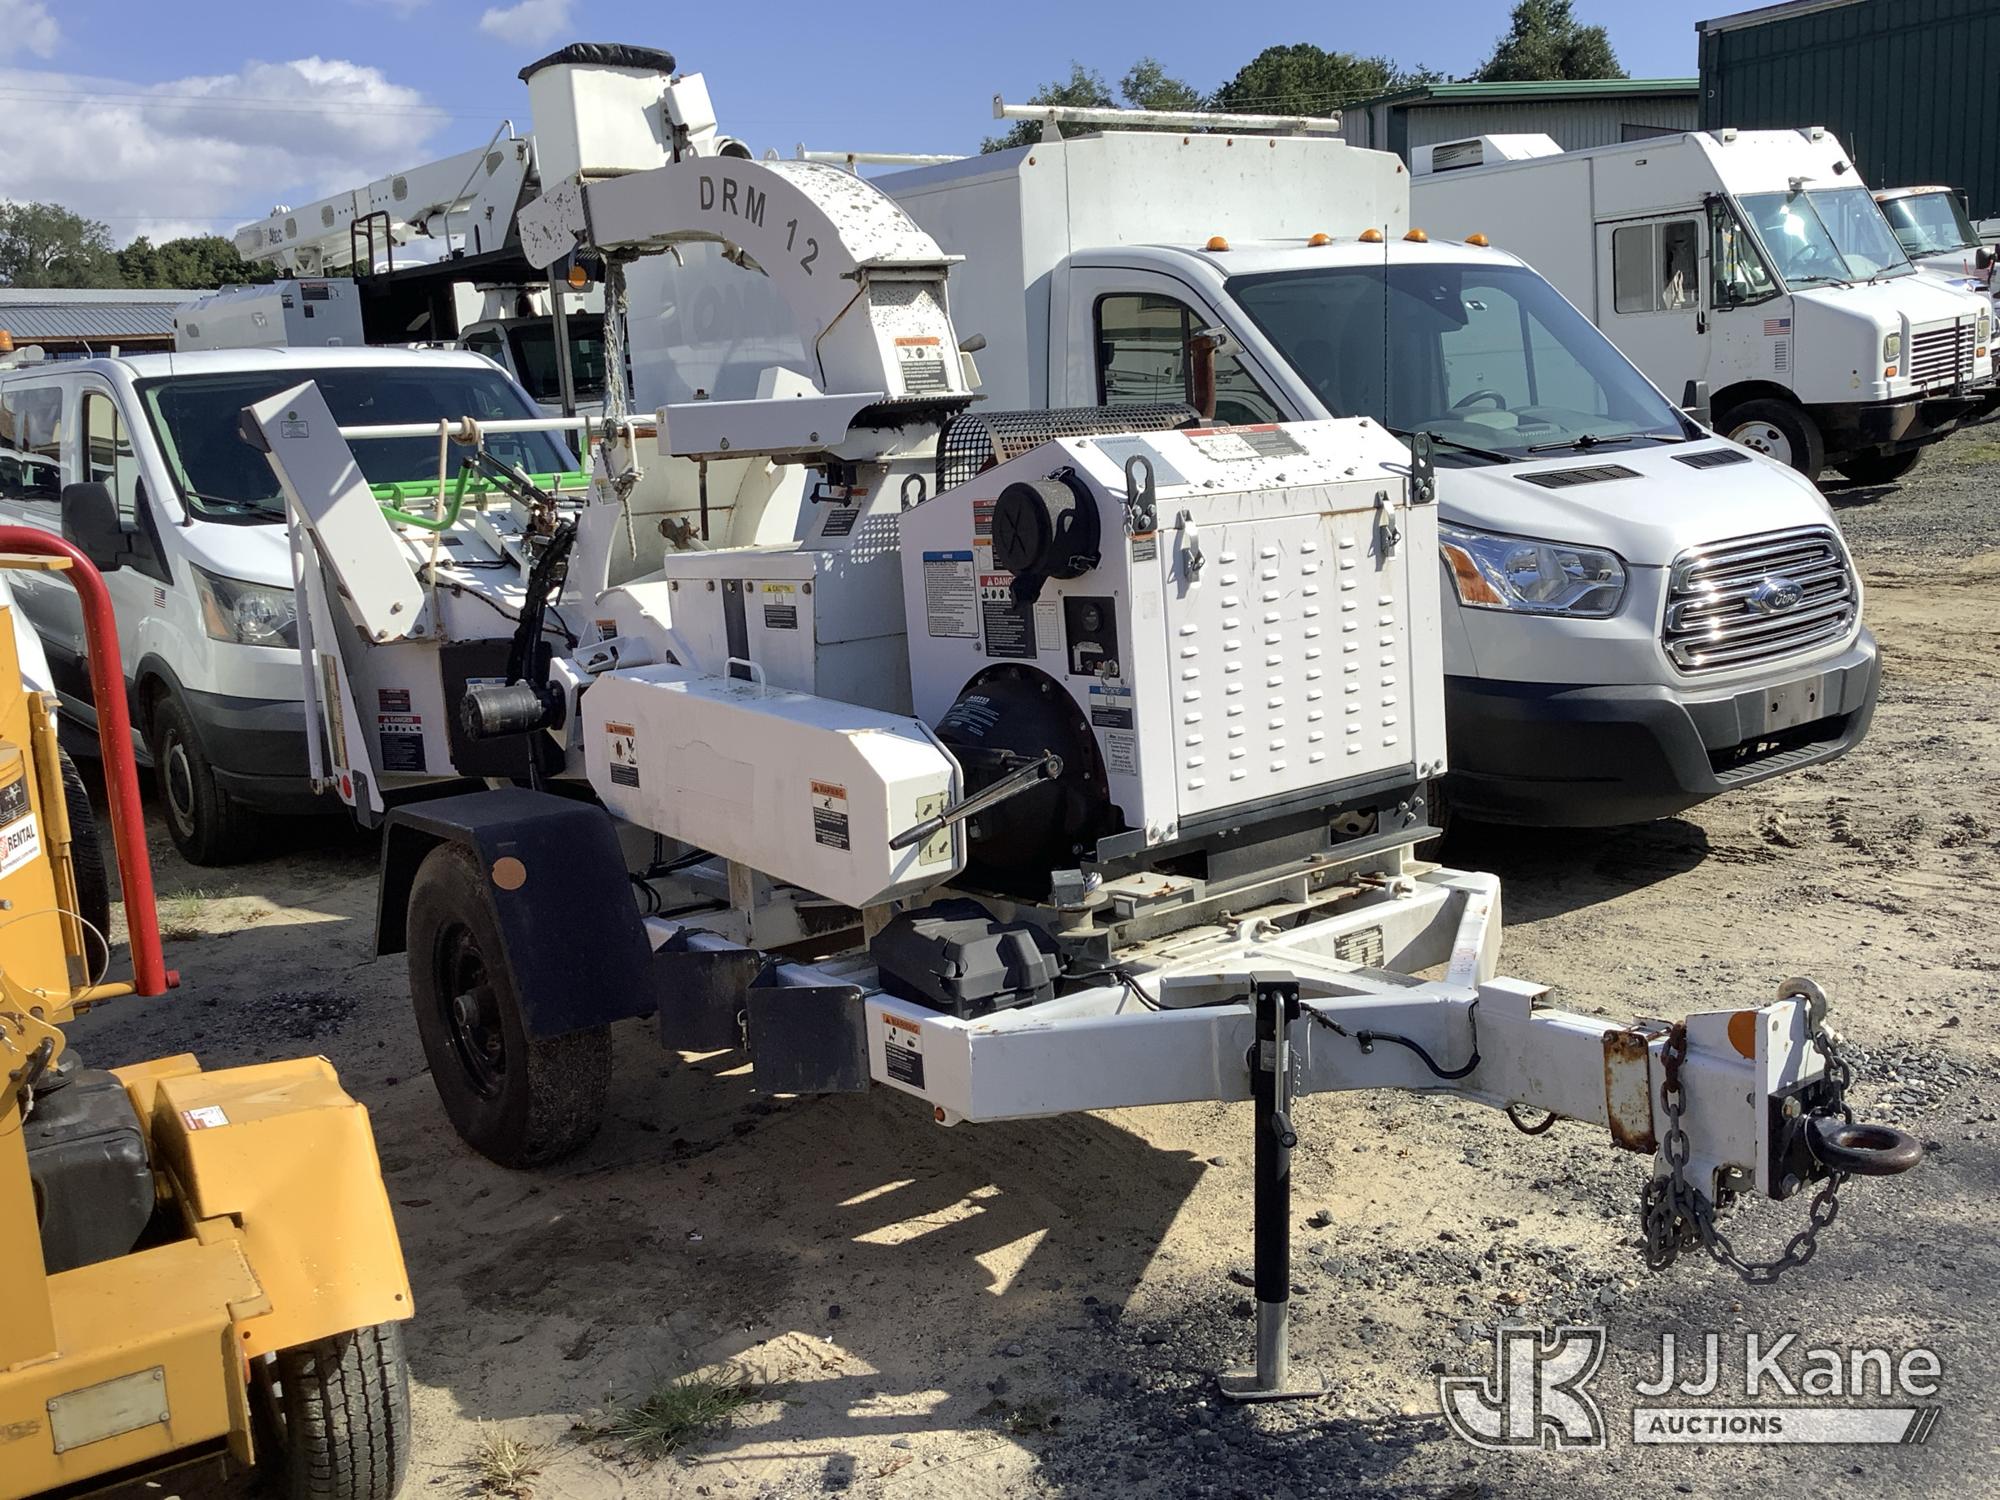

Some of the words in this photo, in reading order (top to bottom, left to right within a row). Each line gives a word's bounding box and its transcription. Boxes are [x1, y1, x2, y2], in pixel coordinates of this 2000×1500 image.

[699, 175, 767, 228] DRM
[786, 218, 819, 276] 12
[268, 226, 283, 245] Altec
[993, 577, 1015, 586] DANG
[1774, 587, 1797, 606] Ford
[7, 823, 35, 852] RENTAL
